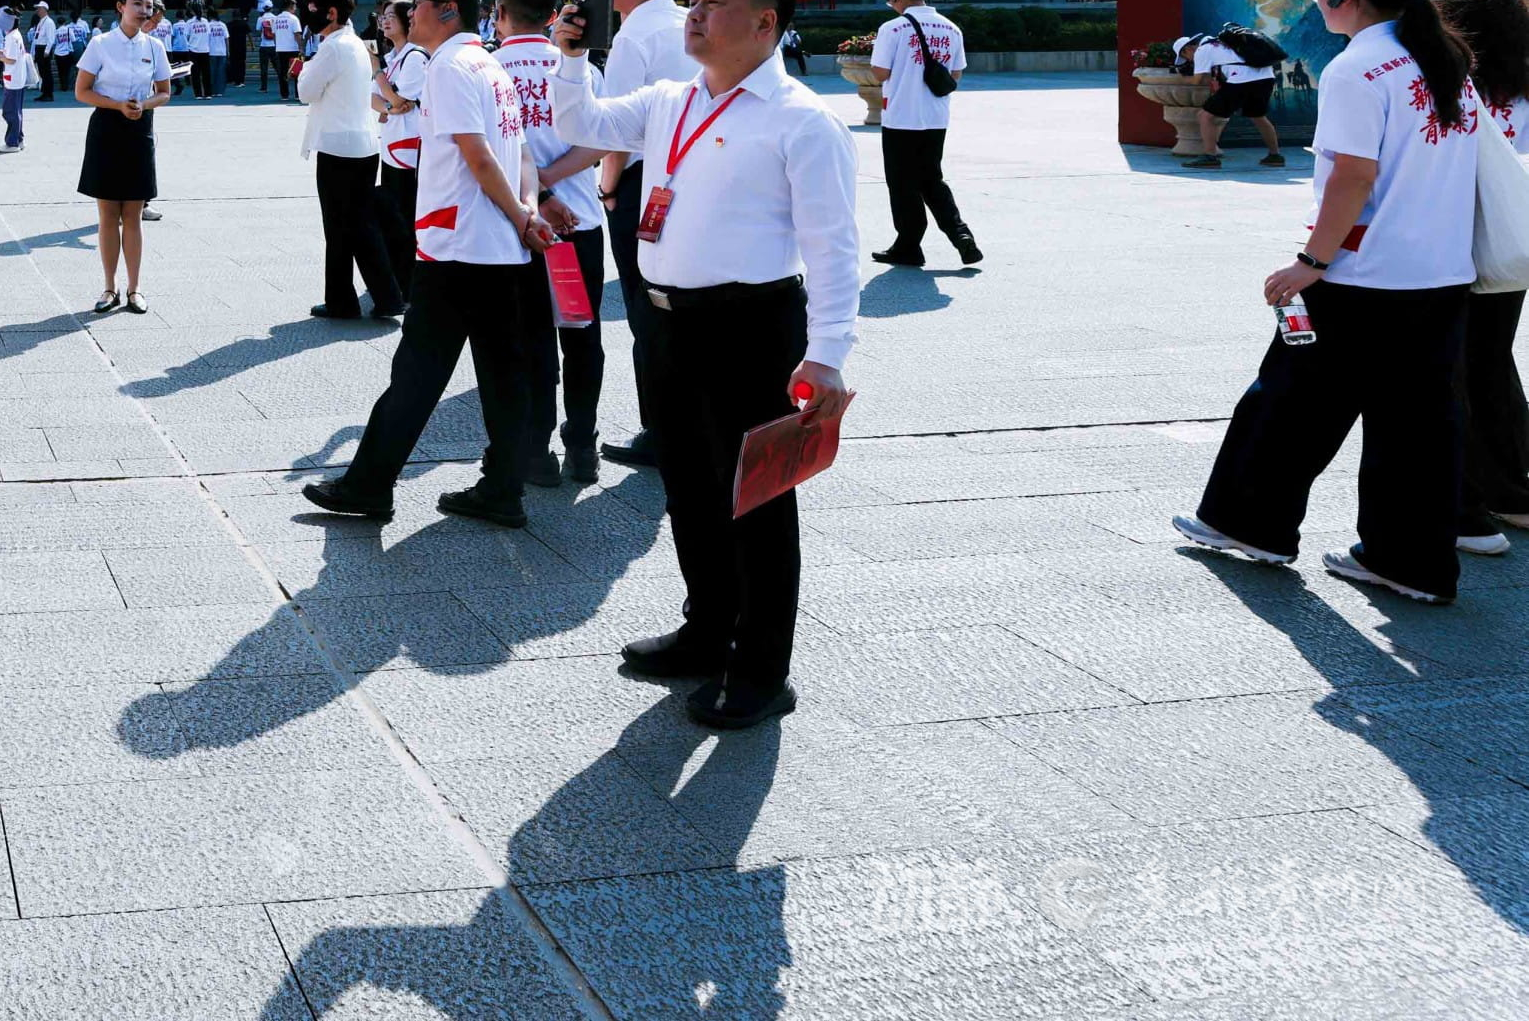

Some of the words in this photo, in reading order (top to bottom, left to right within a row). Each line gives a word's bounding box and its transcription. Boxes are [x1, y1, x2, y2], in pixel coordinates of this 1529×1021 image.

[908, 33, 951, 49] 薪相传
[911, 50, 952, 65] 青接力
